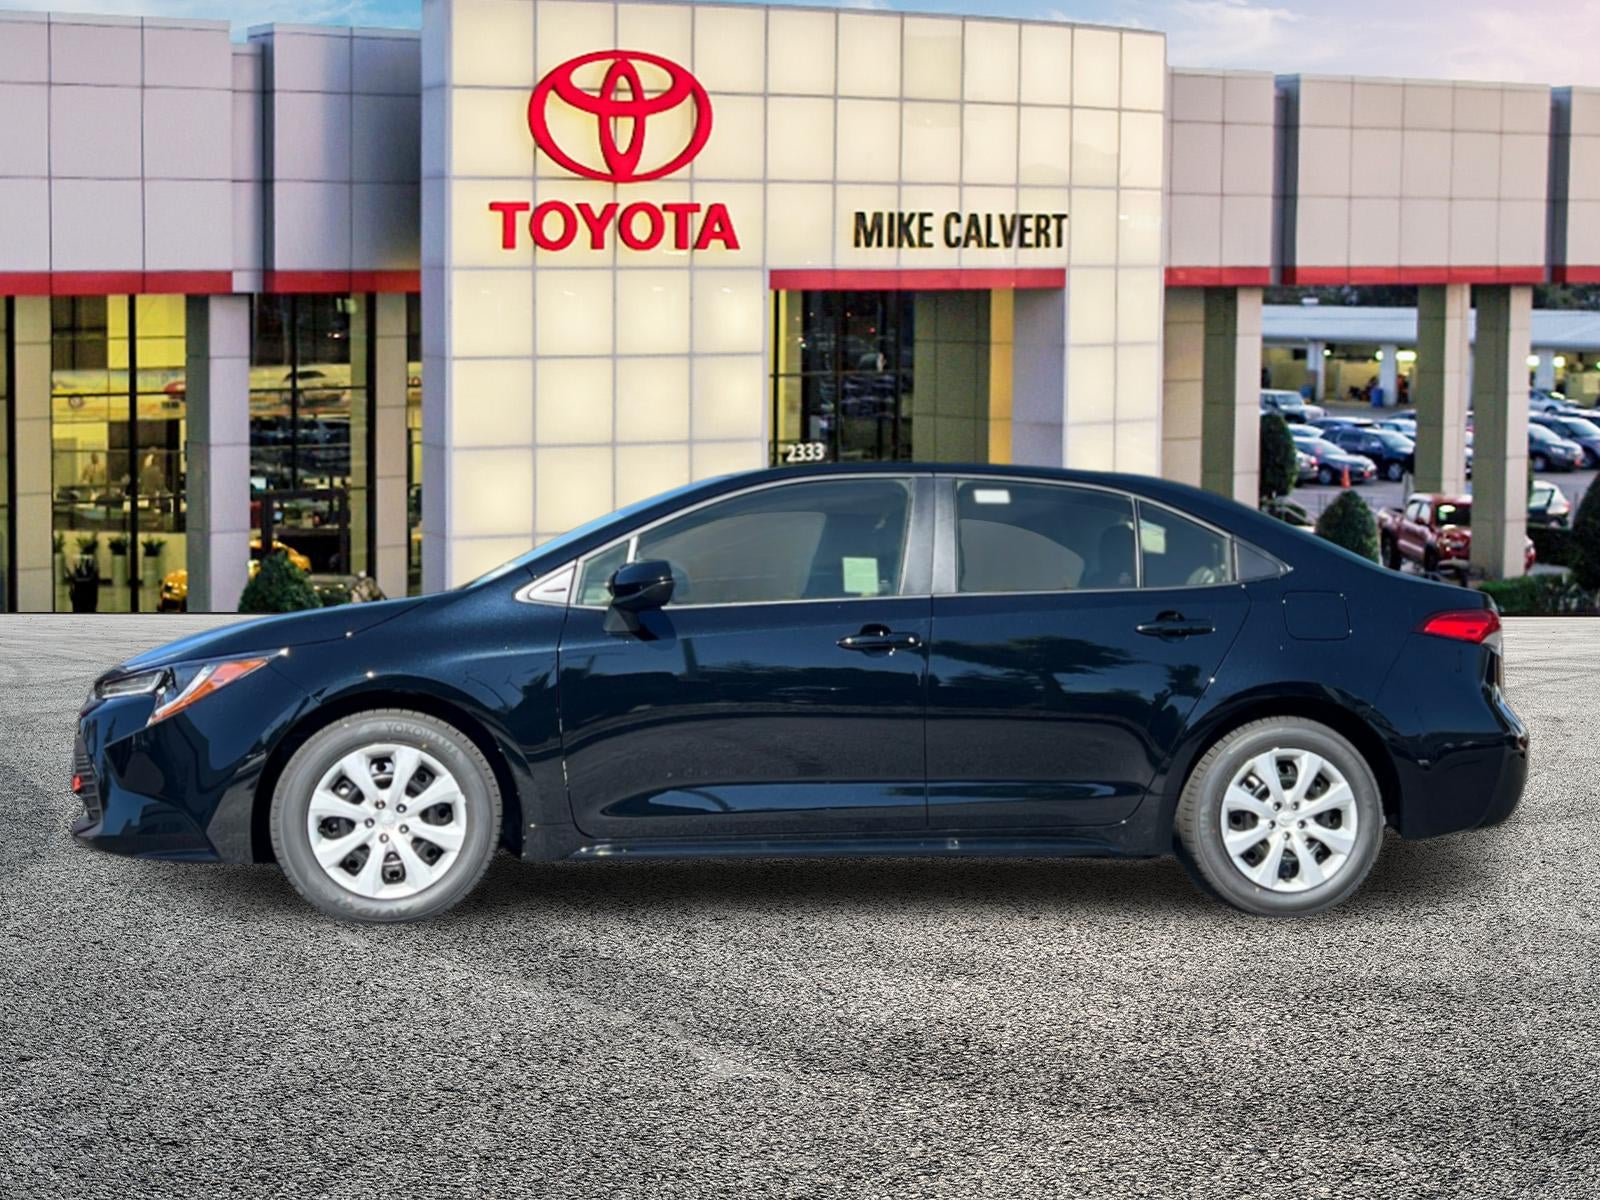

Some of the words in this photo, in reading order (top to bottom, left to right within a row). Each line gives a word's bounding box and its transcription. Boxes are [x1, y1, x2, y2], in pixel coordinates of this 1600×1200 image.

[488, 200, 740, 251] TOYOTA
[853, 211, 934, 248] MIKE
[943, 211, 1068, 248] CALVERT
[786, 442, 825, 462] 2333
